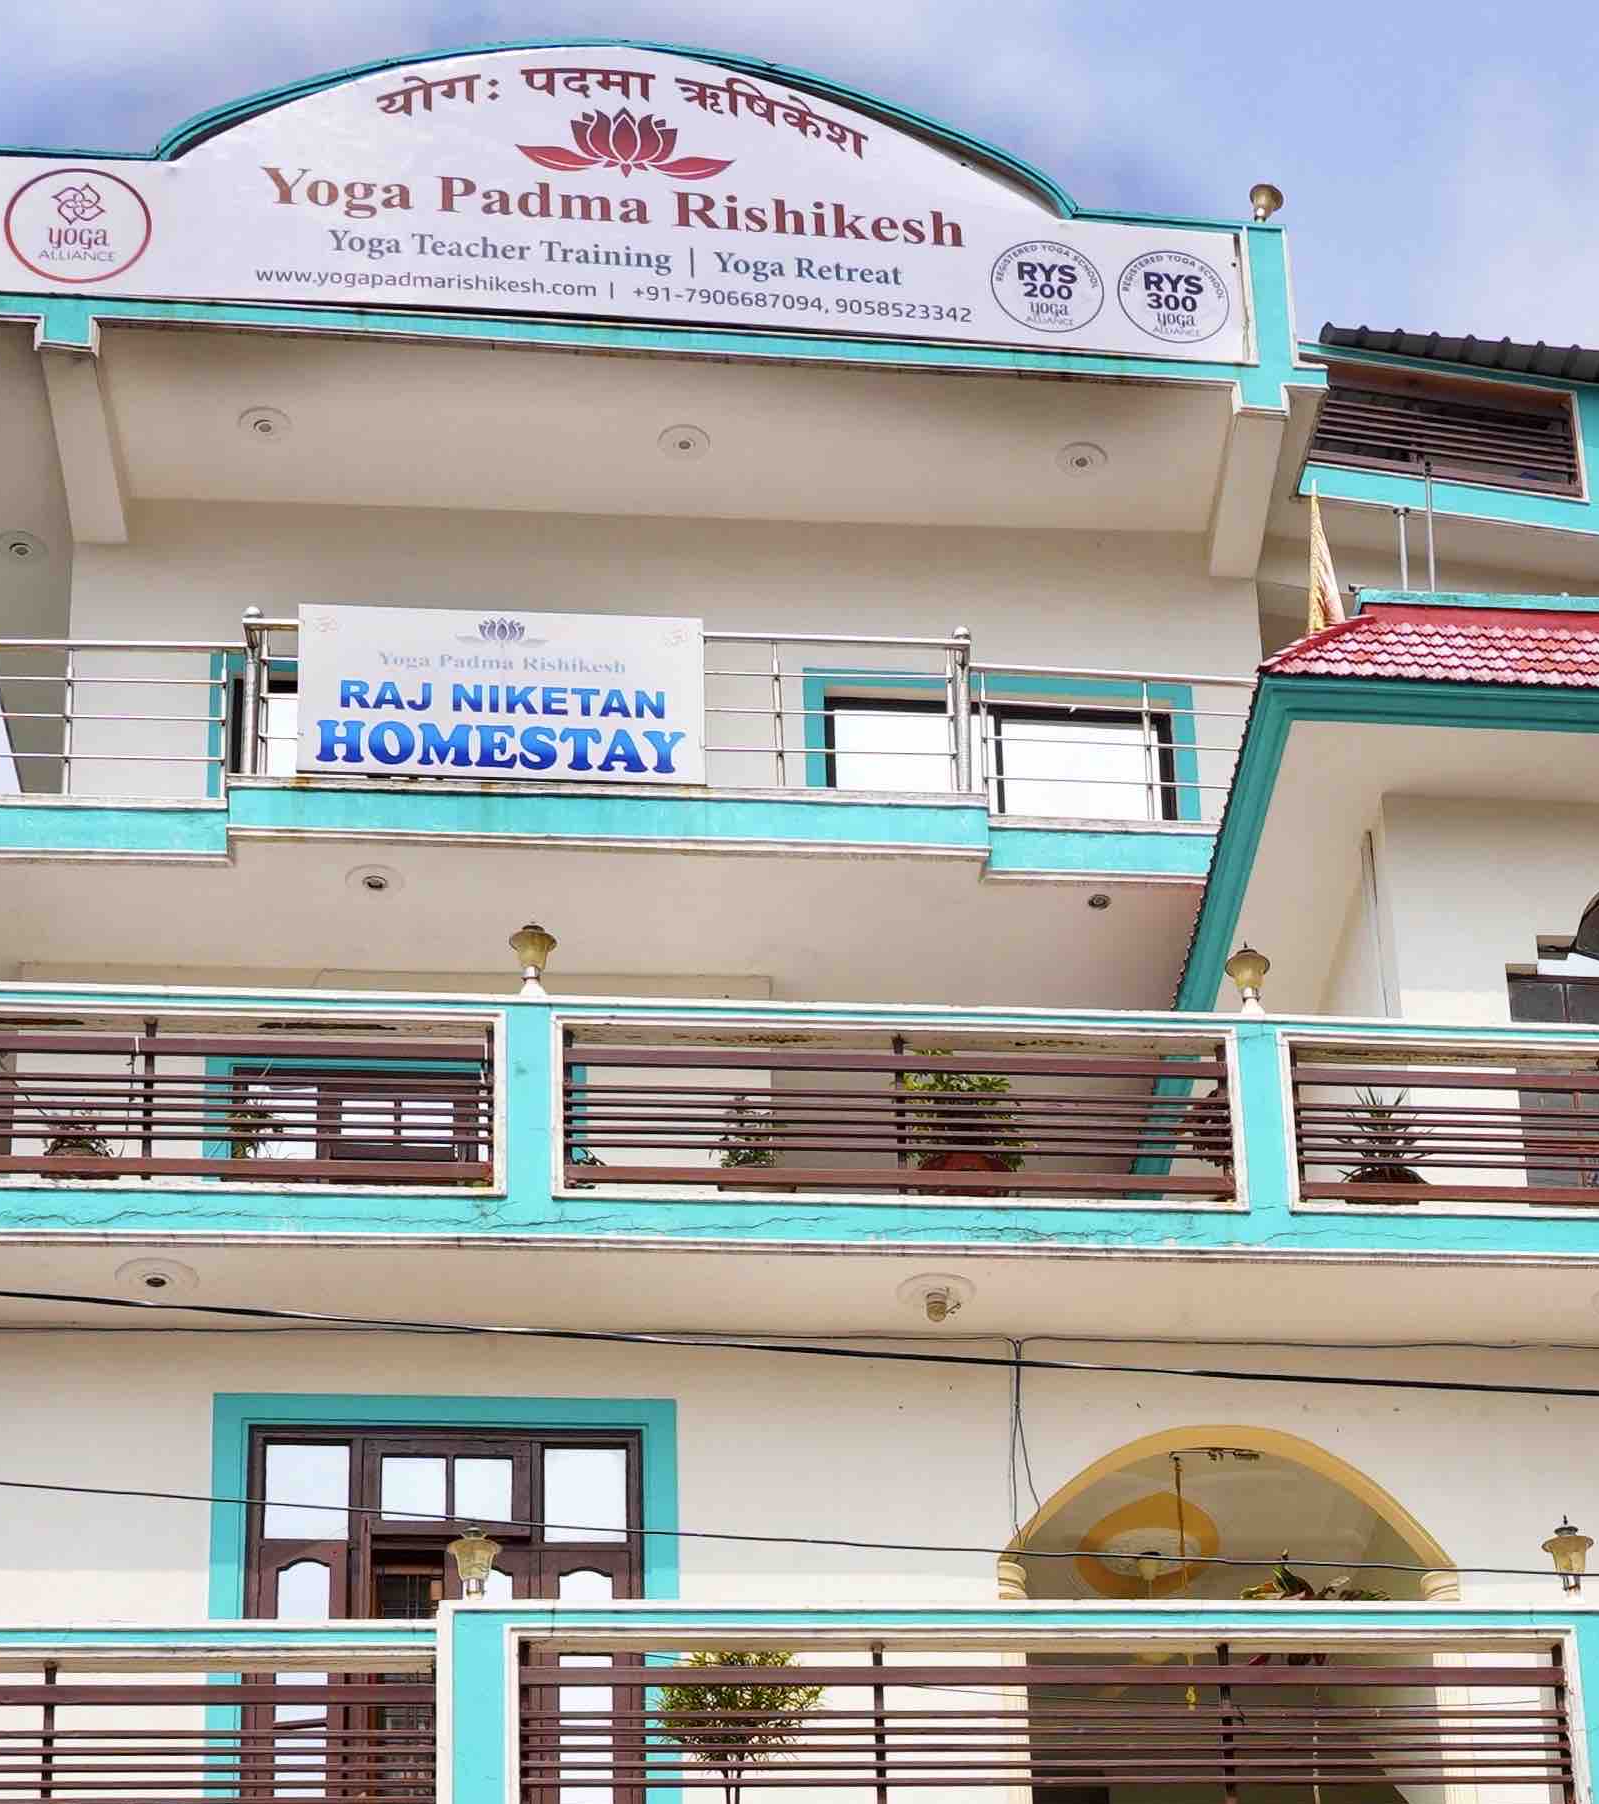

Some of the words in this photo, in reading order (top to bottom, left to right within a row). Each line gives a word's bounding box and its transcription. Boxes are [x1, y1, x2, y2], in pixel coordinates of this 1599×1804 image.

[520, 67, 656, 101] पदमा
[675, 77, 868, 158] ऋषिकेश
[261, 167, 414, 219] Yoga
[437, 175, 650, 225] Padma
[672, 190, 966, 248] Rishikesh
[48, 226, 109, 250] yoga
[38, 249, 116, 262] ALLIANCE
[329, 230, 402, 260] Yoga
[412, 233, 531, 261] Teacher
[539, 240, 673, 275] Training
[713, 251, 786, 282] Yoga
[795, 256, 904, 286] Retreat
[1017, 261, 1078, 284] RYS
[1143, 271, 1204, 295] RYS
[256, 268, 597, 297] www.yogapadmarishikesh.com
[633, 286, 829, 315] +91-7906687094,
[835, 298, 972, 323] 9058523342
[1023, 282, 1073, 300] 200
[1146, 292, 1197, 312] 300
[377, 650, 431, 669] Yoga
[440, 653, 514, 671] Padma
[522, 654, 627, 673] Rishikesh
[340, 679, 432, 711] RAJ
[452, 683, 666, 719] NIKETAN
[315, 719, 687, 774] HOMESTAY
